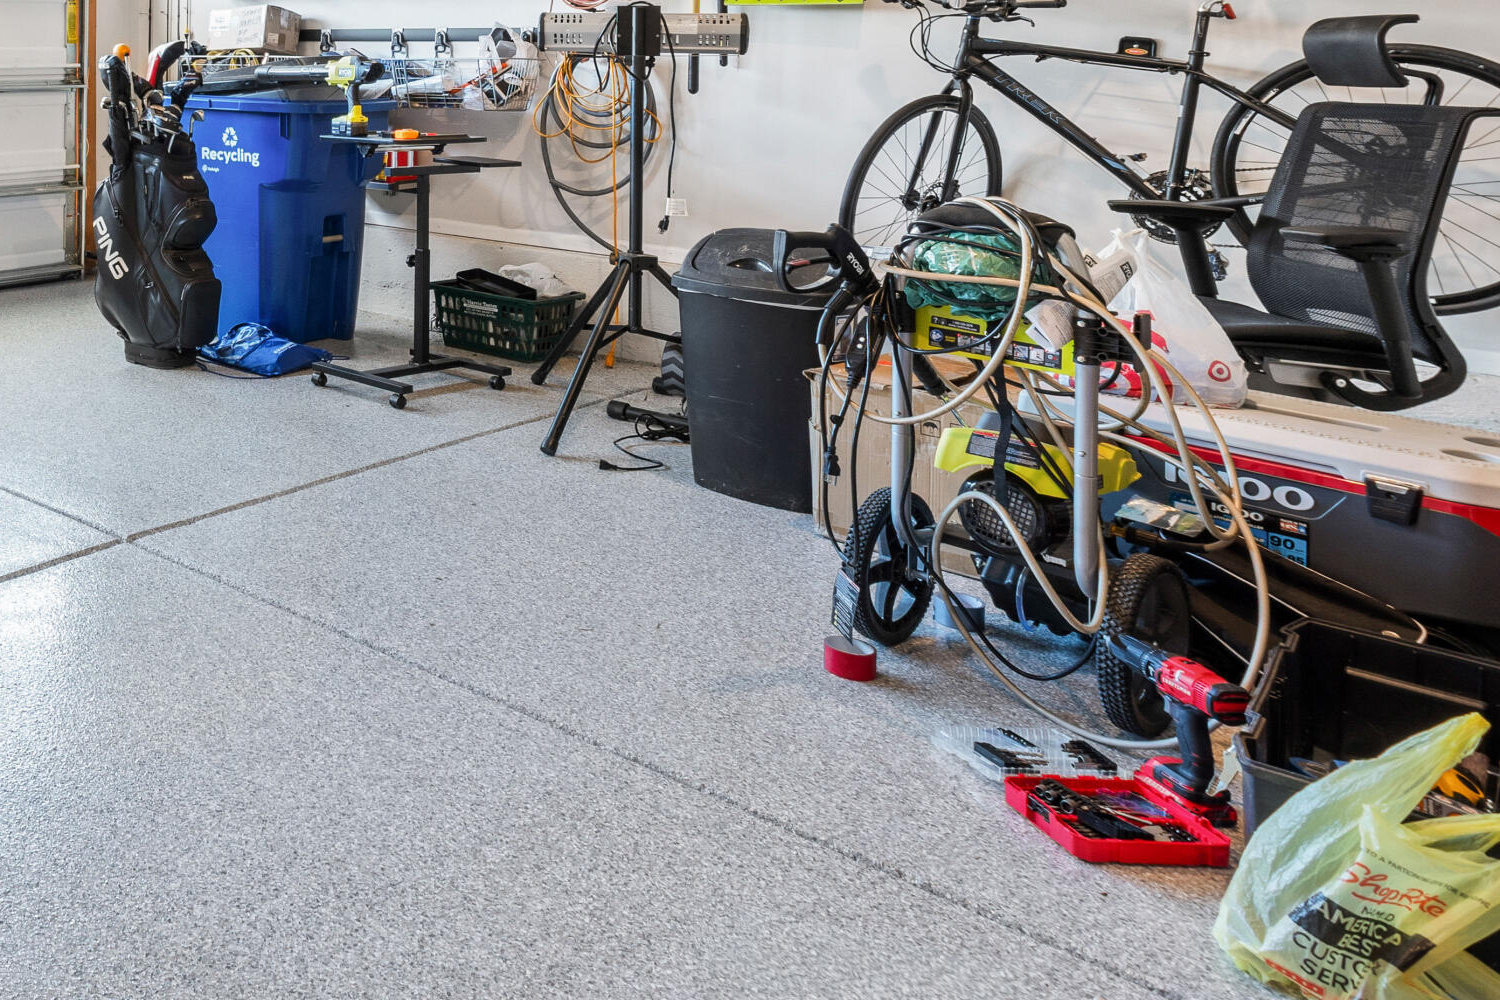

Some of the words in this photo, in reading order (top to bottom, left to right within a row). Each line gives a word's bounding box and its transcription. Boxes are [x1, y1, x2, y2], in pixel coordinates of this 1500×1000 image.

[994, 71, 1066, 124] TREK
[201, 146, 260, 167] Recycling
[92, 215, 129, 280] PING
[846, 251, 865, 276] RYOBI
[1211, 502, 1264, 522] IGOO
[1270, 535, 1295, 551] 90
[1162, 677, 1192, 697] CRAFTSMAN
[1343, 862, 1448, 918] ShopRte
[1338, 932, 1381, 957] BES
